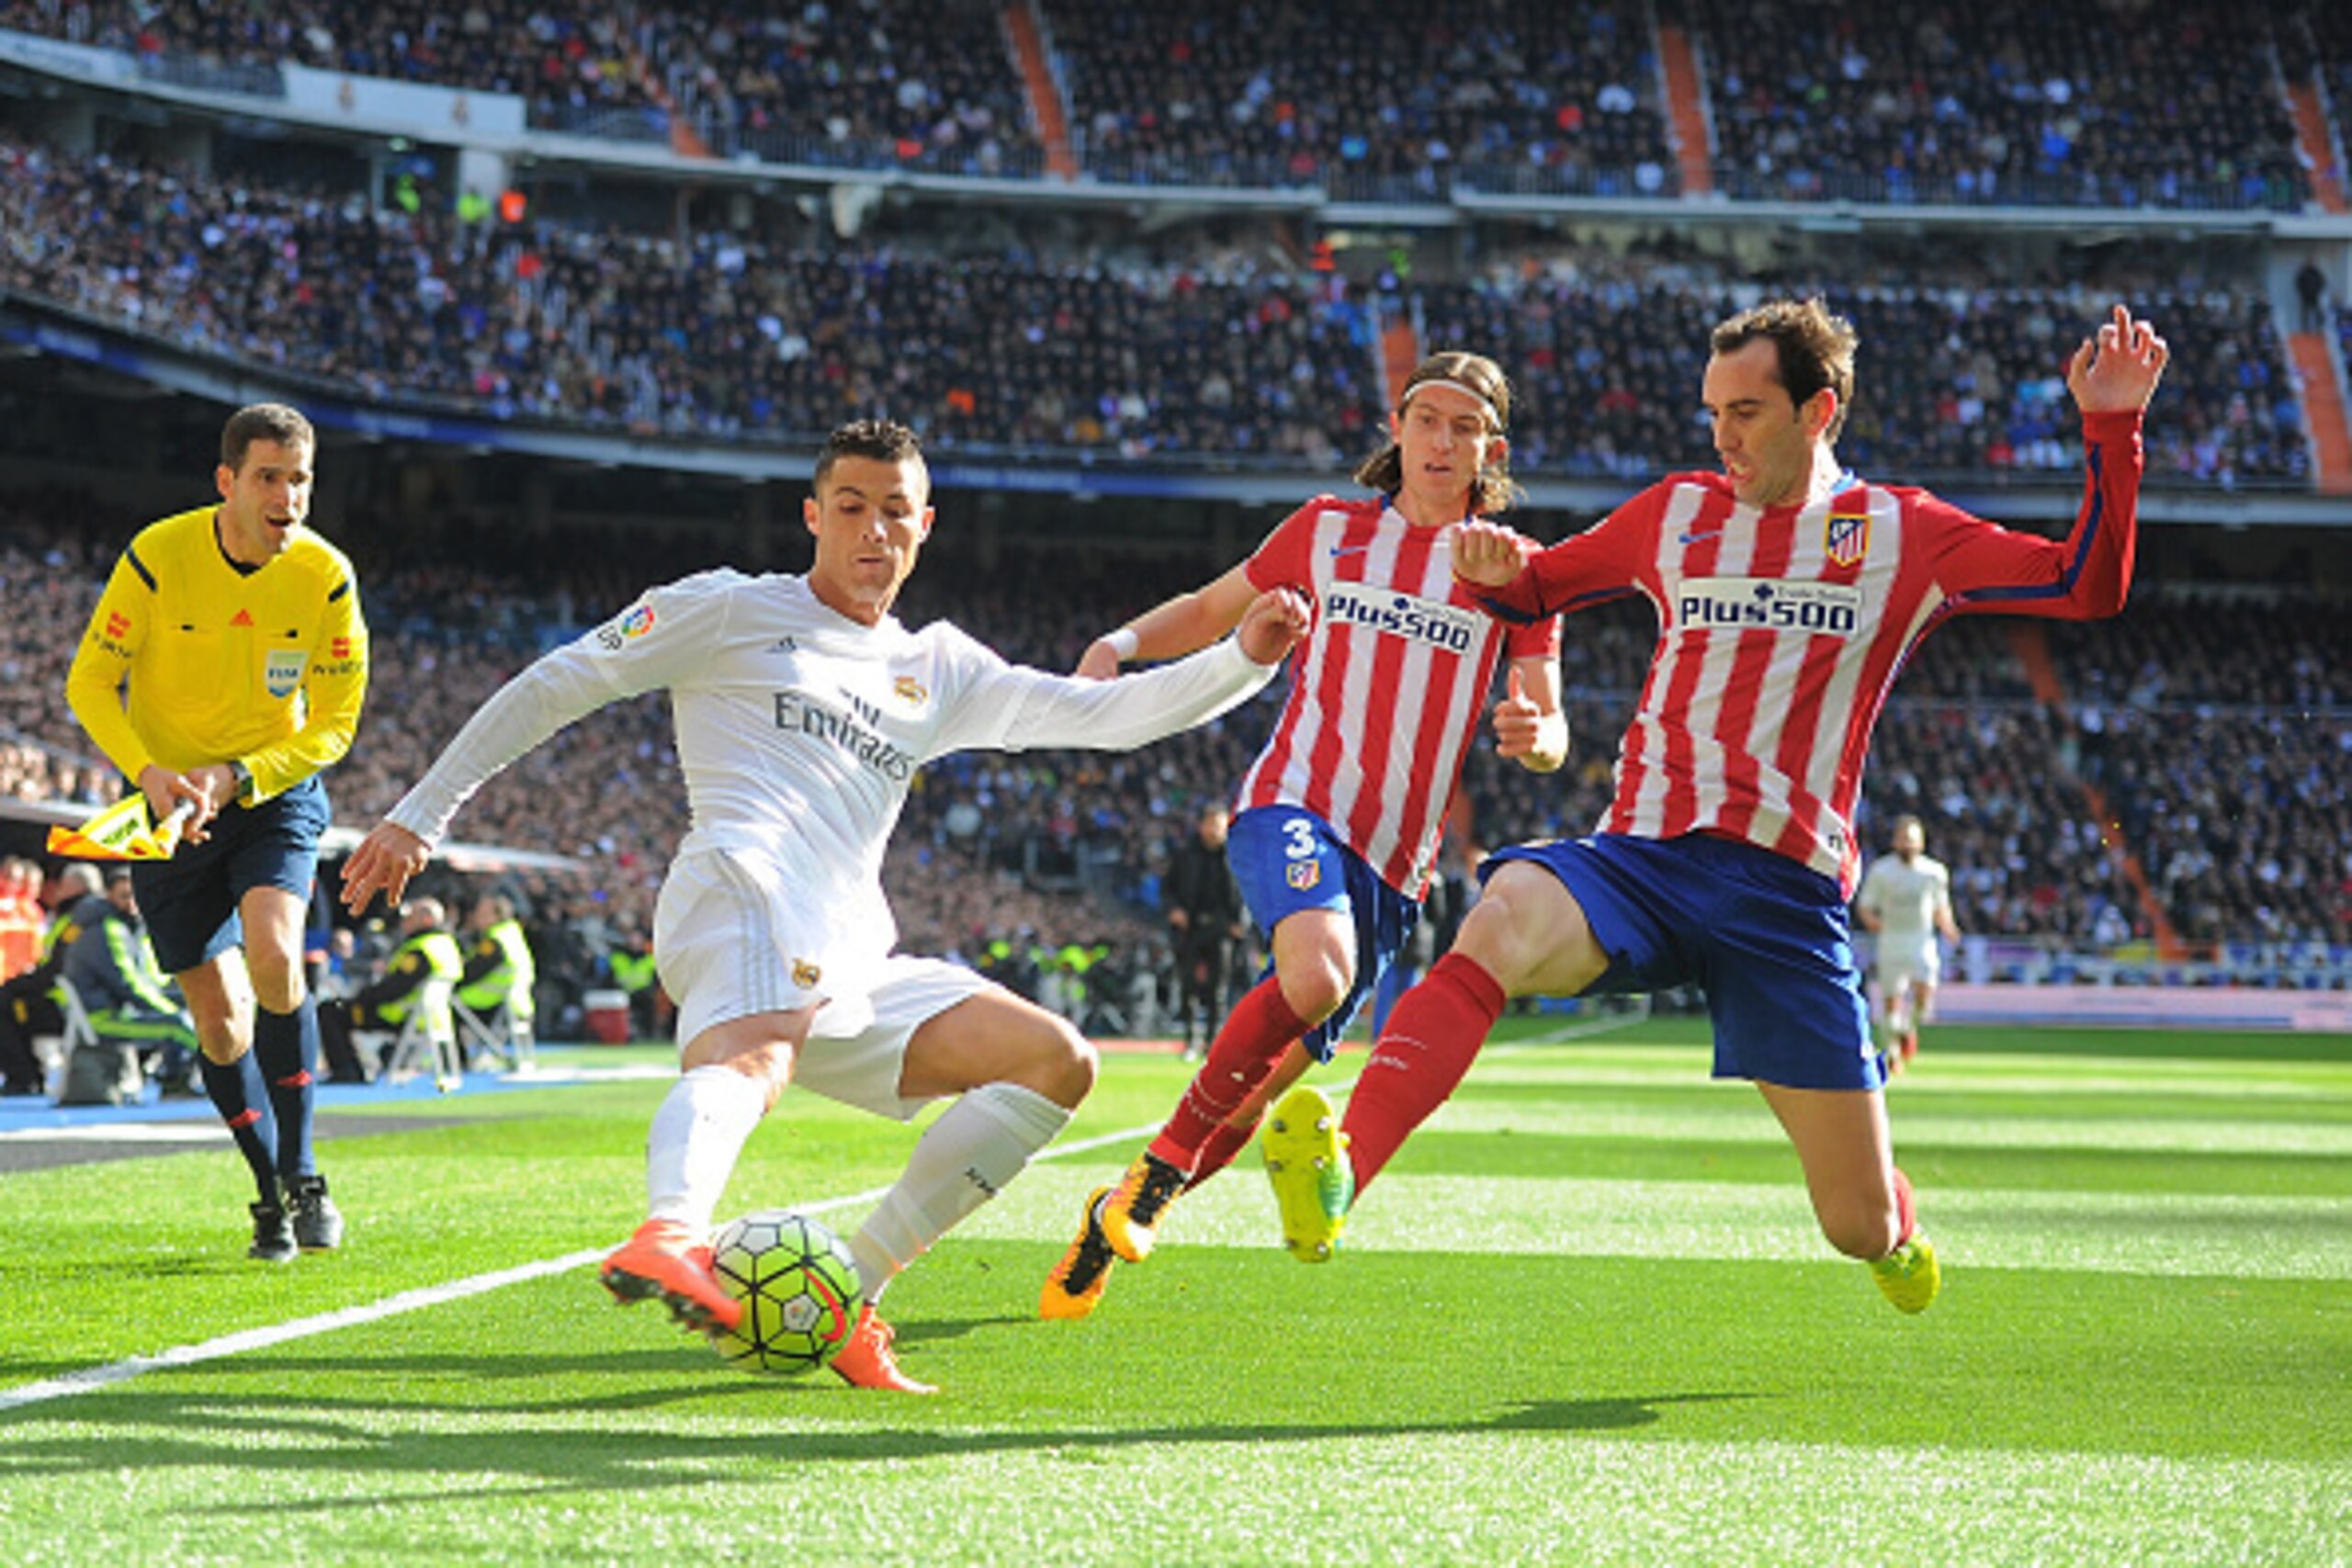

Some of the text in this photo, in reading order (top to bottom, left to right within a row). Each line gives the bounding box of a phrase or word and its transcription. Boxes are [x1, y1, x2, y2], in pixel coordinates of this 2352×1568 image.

[1328, 594, 1470, 651] Plus500
[1681, 597, 1854, 631] Plus500
[774, 691, 915, 781] Emirates
[1282, 818, 1316, 860] 3
